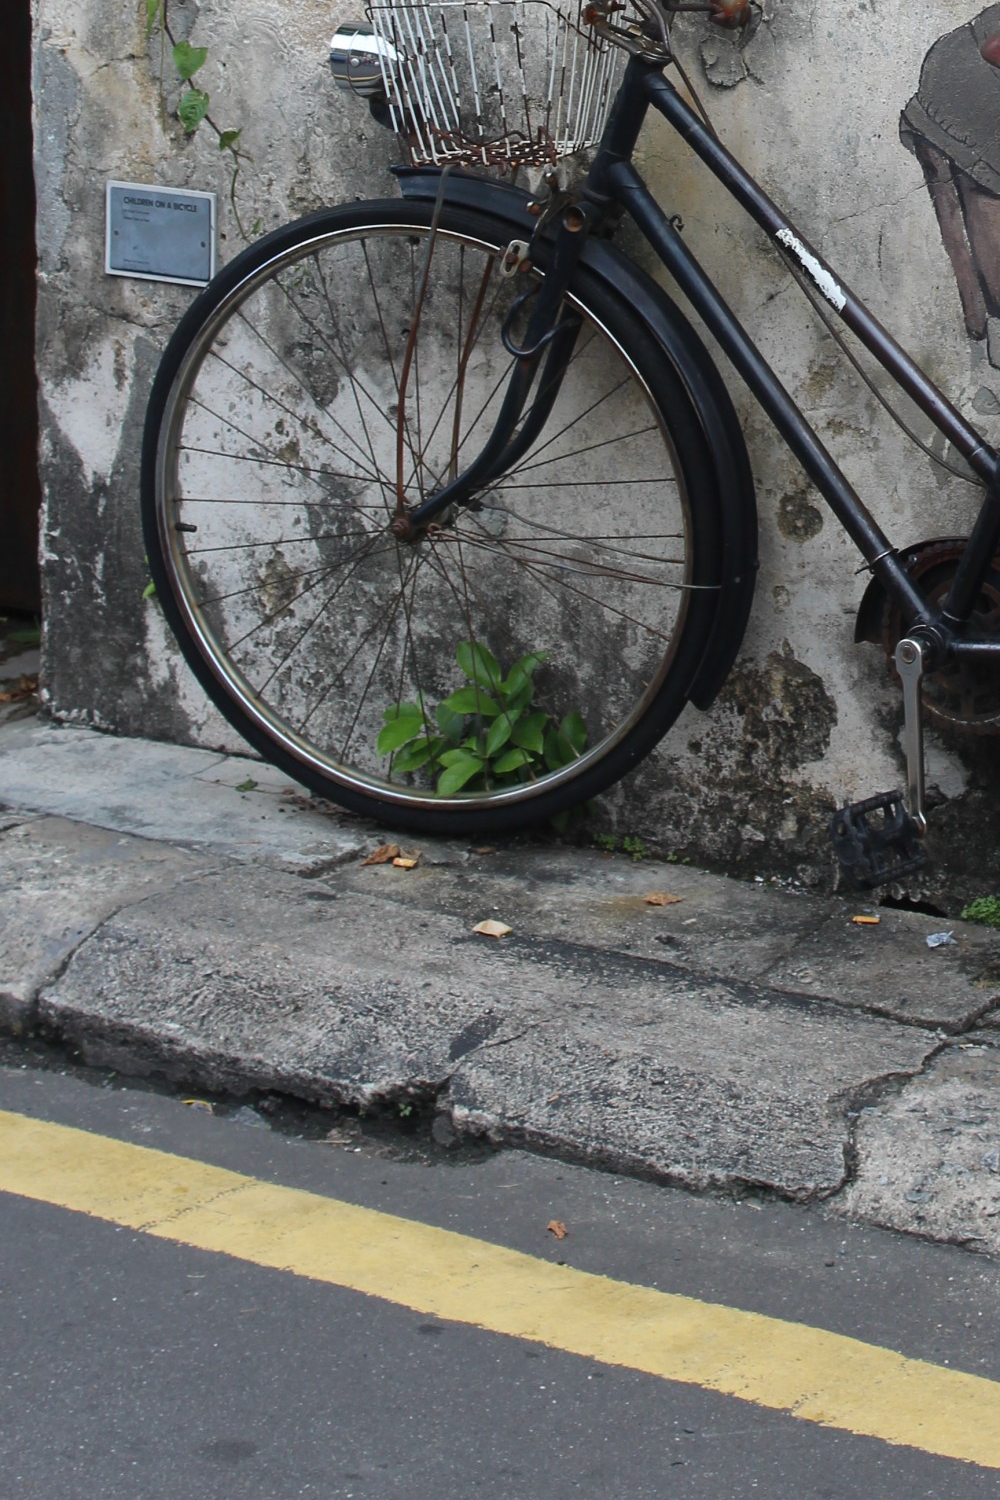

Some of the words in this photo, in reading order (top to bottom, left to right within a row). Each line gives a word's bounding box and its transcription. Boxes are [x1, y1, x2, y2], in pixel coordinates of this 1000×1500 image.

[123, 196, 153, 206] CHILDREN
[155, 200, 165, 208] ON
[173, 203, 197, 212] BICYCLE
